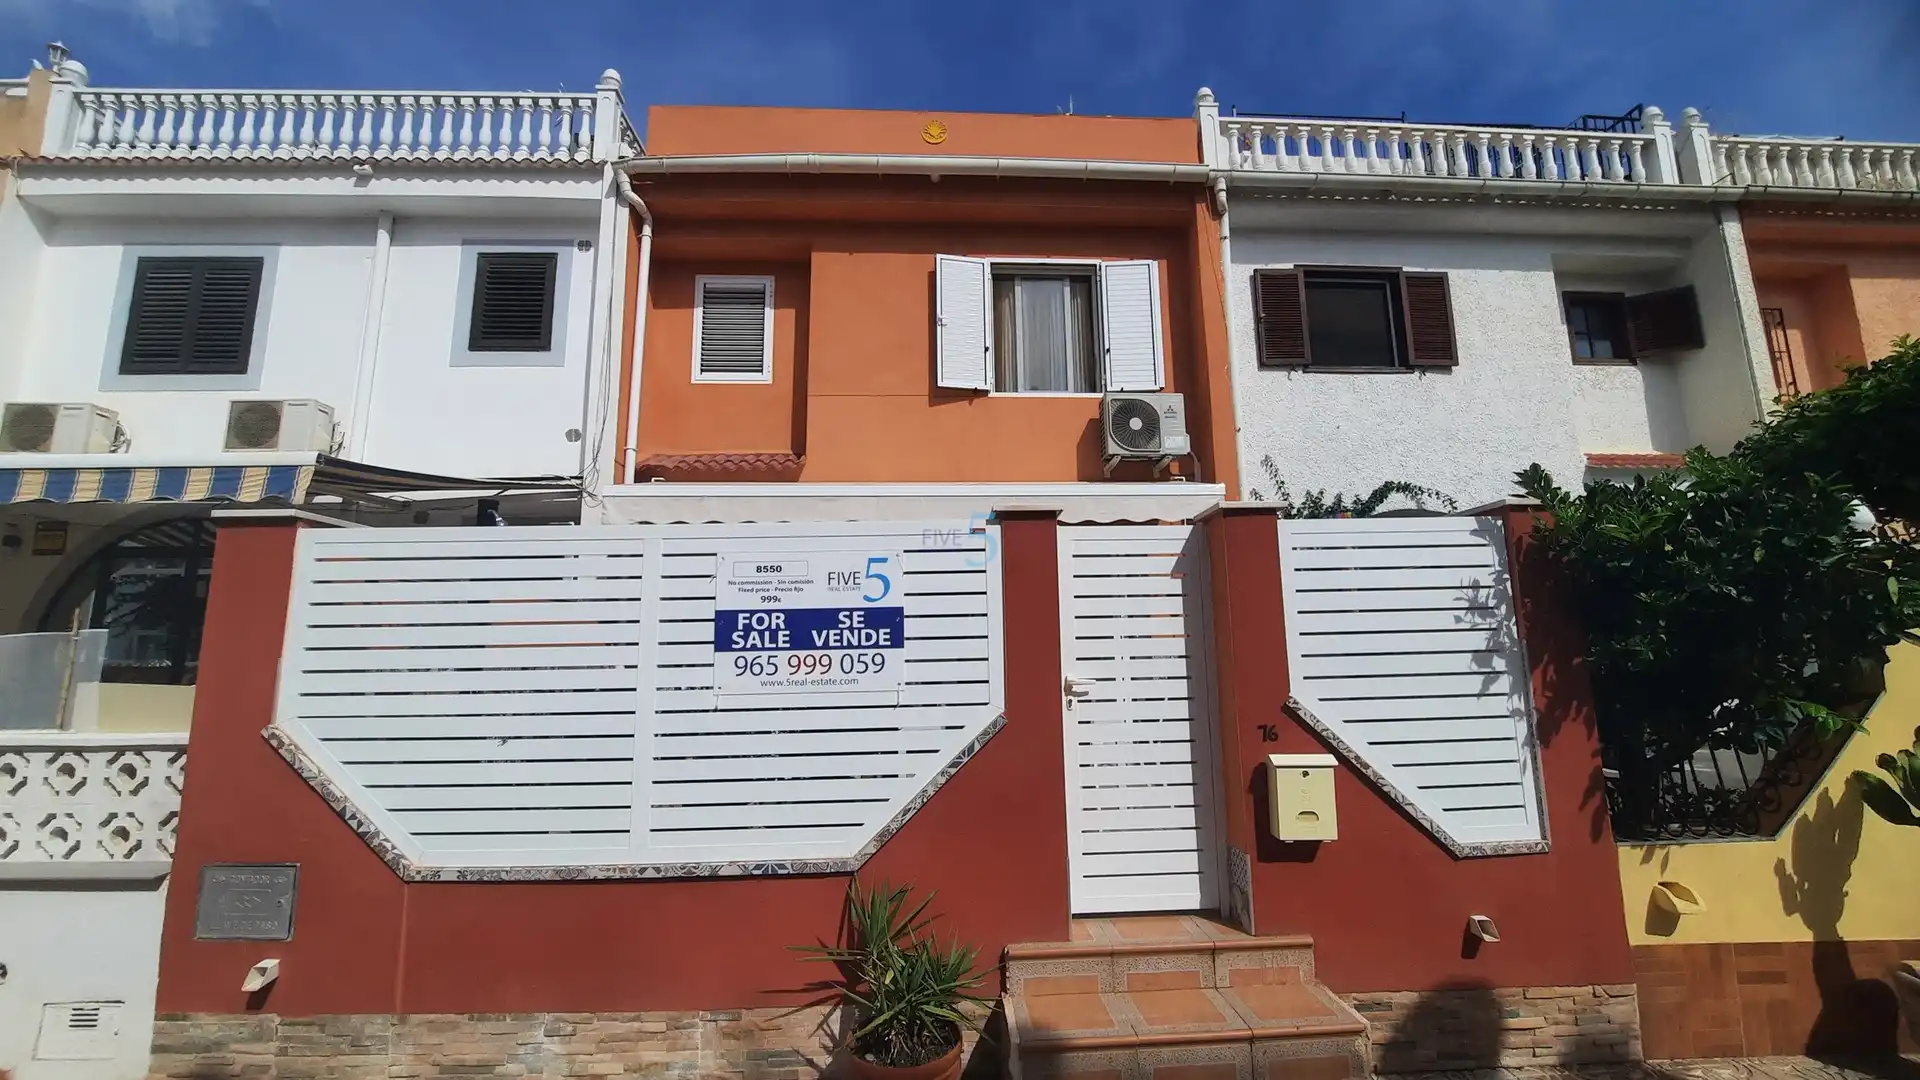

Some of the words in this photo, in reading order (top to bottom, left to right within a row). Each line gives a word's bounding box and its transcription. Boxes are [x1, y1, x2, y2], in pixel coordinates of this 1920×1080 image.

[755, 565, 782, 574] 8550
[827, 571, 862, 586] FIVE
[862, 557, 891, 603] 5
[737, 612, 786, 630] FOR
[837, 611, 865, 629] SE
[731, 630, 791, 649] SALE
[811, 628, 891, 647] VENDE
[734, 655, 779, 677] 965
[787, 653, 833, 676] 999
[840, 652, 886, 675] 059
[760, 677, 859, 687] www.5real-estate.com
[1257, 724, 1279, 742] 76
